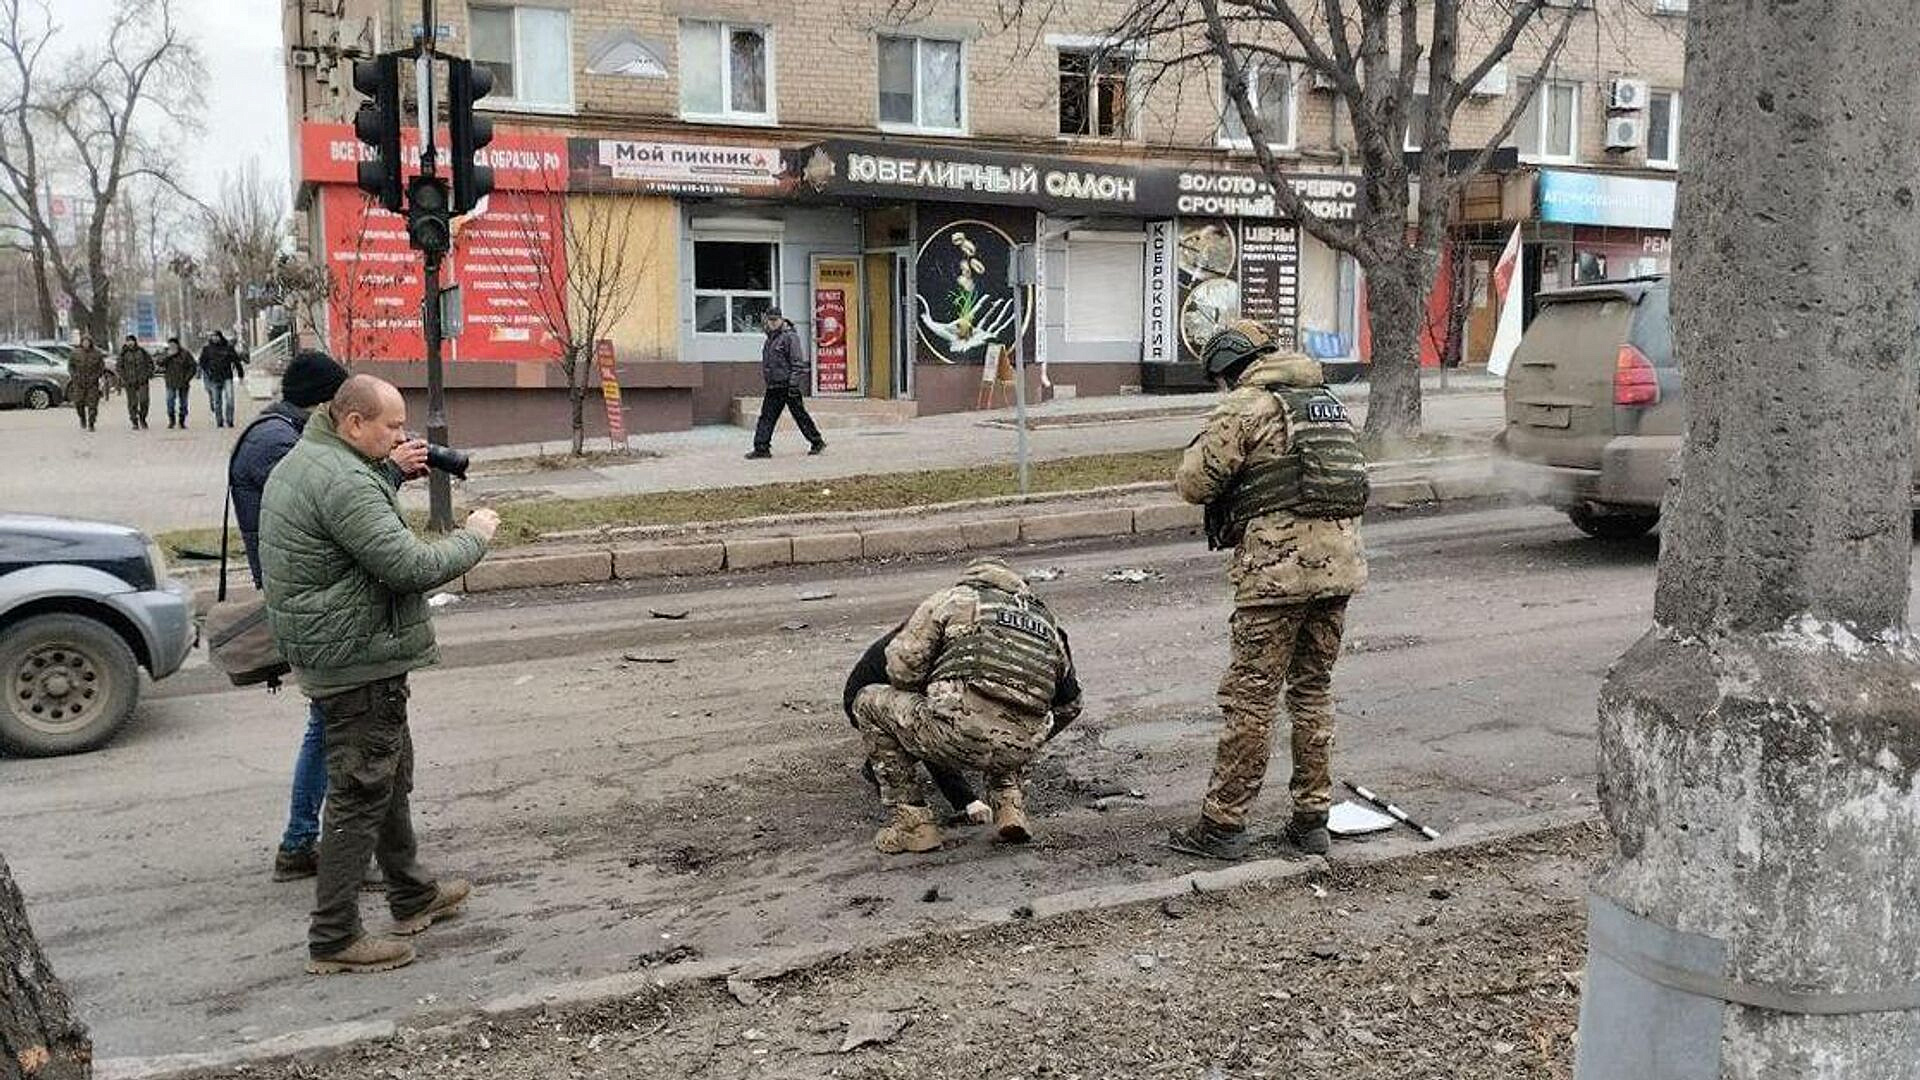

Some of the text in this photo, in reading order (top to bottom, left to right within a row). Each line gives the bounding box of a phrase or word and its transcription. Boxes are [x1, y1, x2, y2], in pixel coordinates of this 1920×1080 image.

[330, 140, 355, 162] ВСЕ
[615, 143, 751, 165] Мой пикник
[847, 152, 1137, 201] ЮВЕЛИРНЫЙ САЛОН
[1178, 173, 1357, 199] ЗОЛОТО РЕБРО
[1177, 194, 1276, 217] СРОЧНЫЙ
[1152, 223, 1164, 358] КСЕРОКОПИЯ
